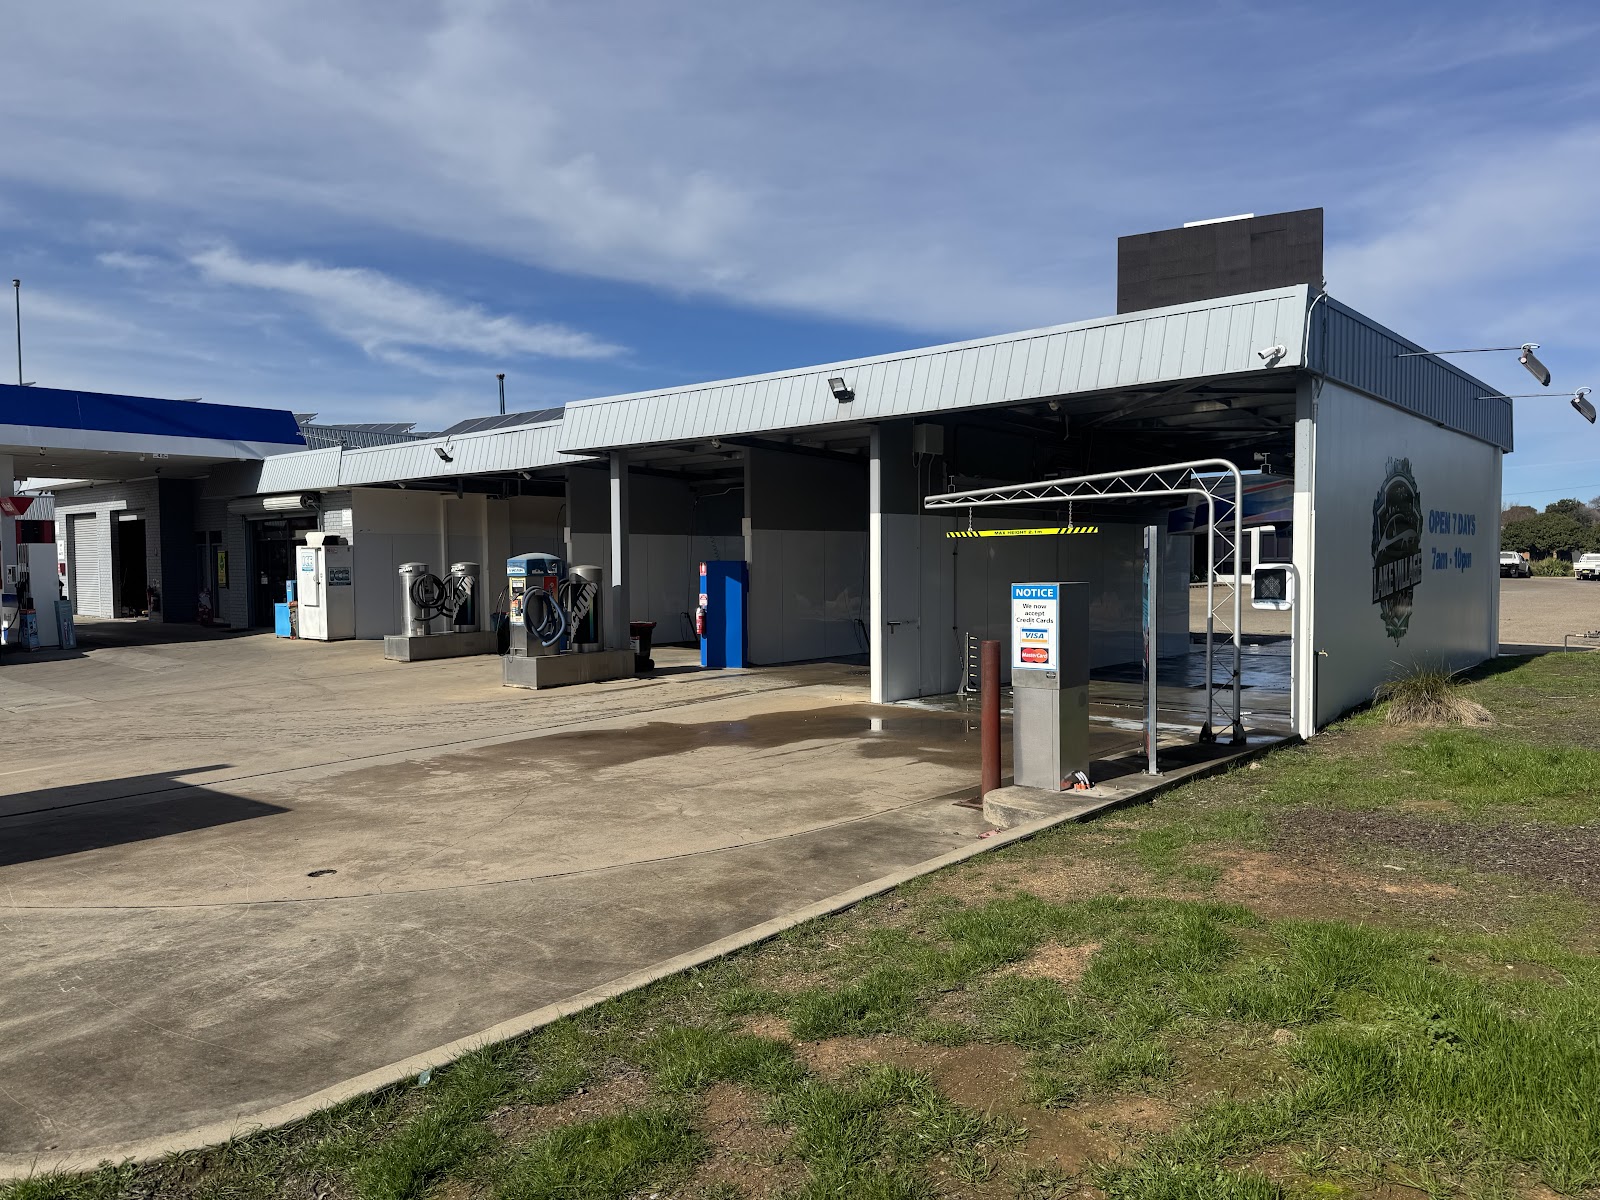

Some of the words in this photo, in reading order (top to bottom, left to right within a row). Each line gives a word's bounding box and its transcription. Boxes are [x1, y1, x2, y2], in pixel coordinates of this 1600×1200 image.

[1429, 509, 1451, 534] OPEN
[1452, 513, 1457, 535] 7
[1457, 513, 1476, 536] DAYS
[1431, 547, 1448, 570] 7am
[1454, 546, 1472, 574] 10pm
[329, 569, 350, 581] ICE
[1373, 562, 1394, 601] LAKE
[1394, 552, 1422, 592] VILLAGE
[1015, 588, 1054, 598] NOTICE
